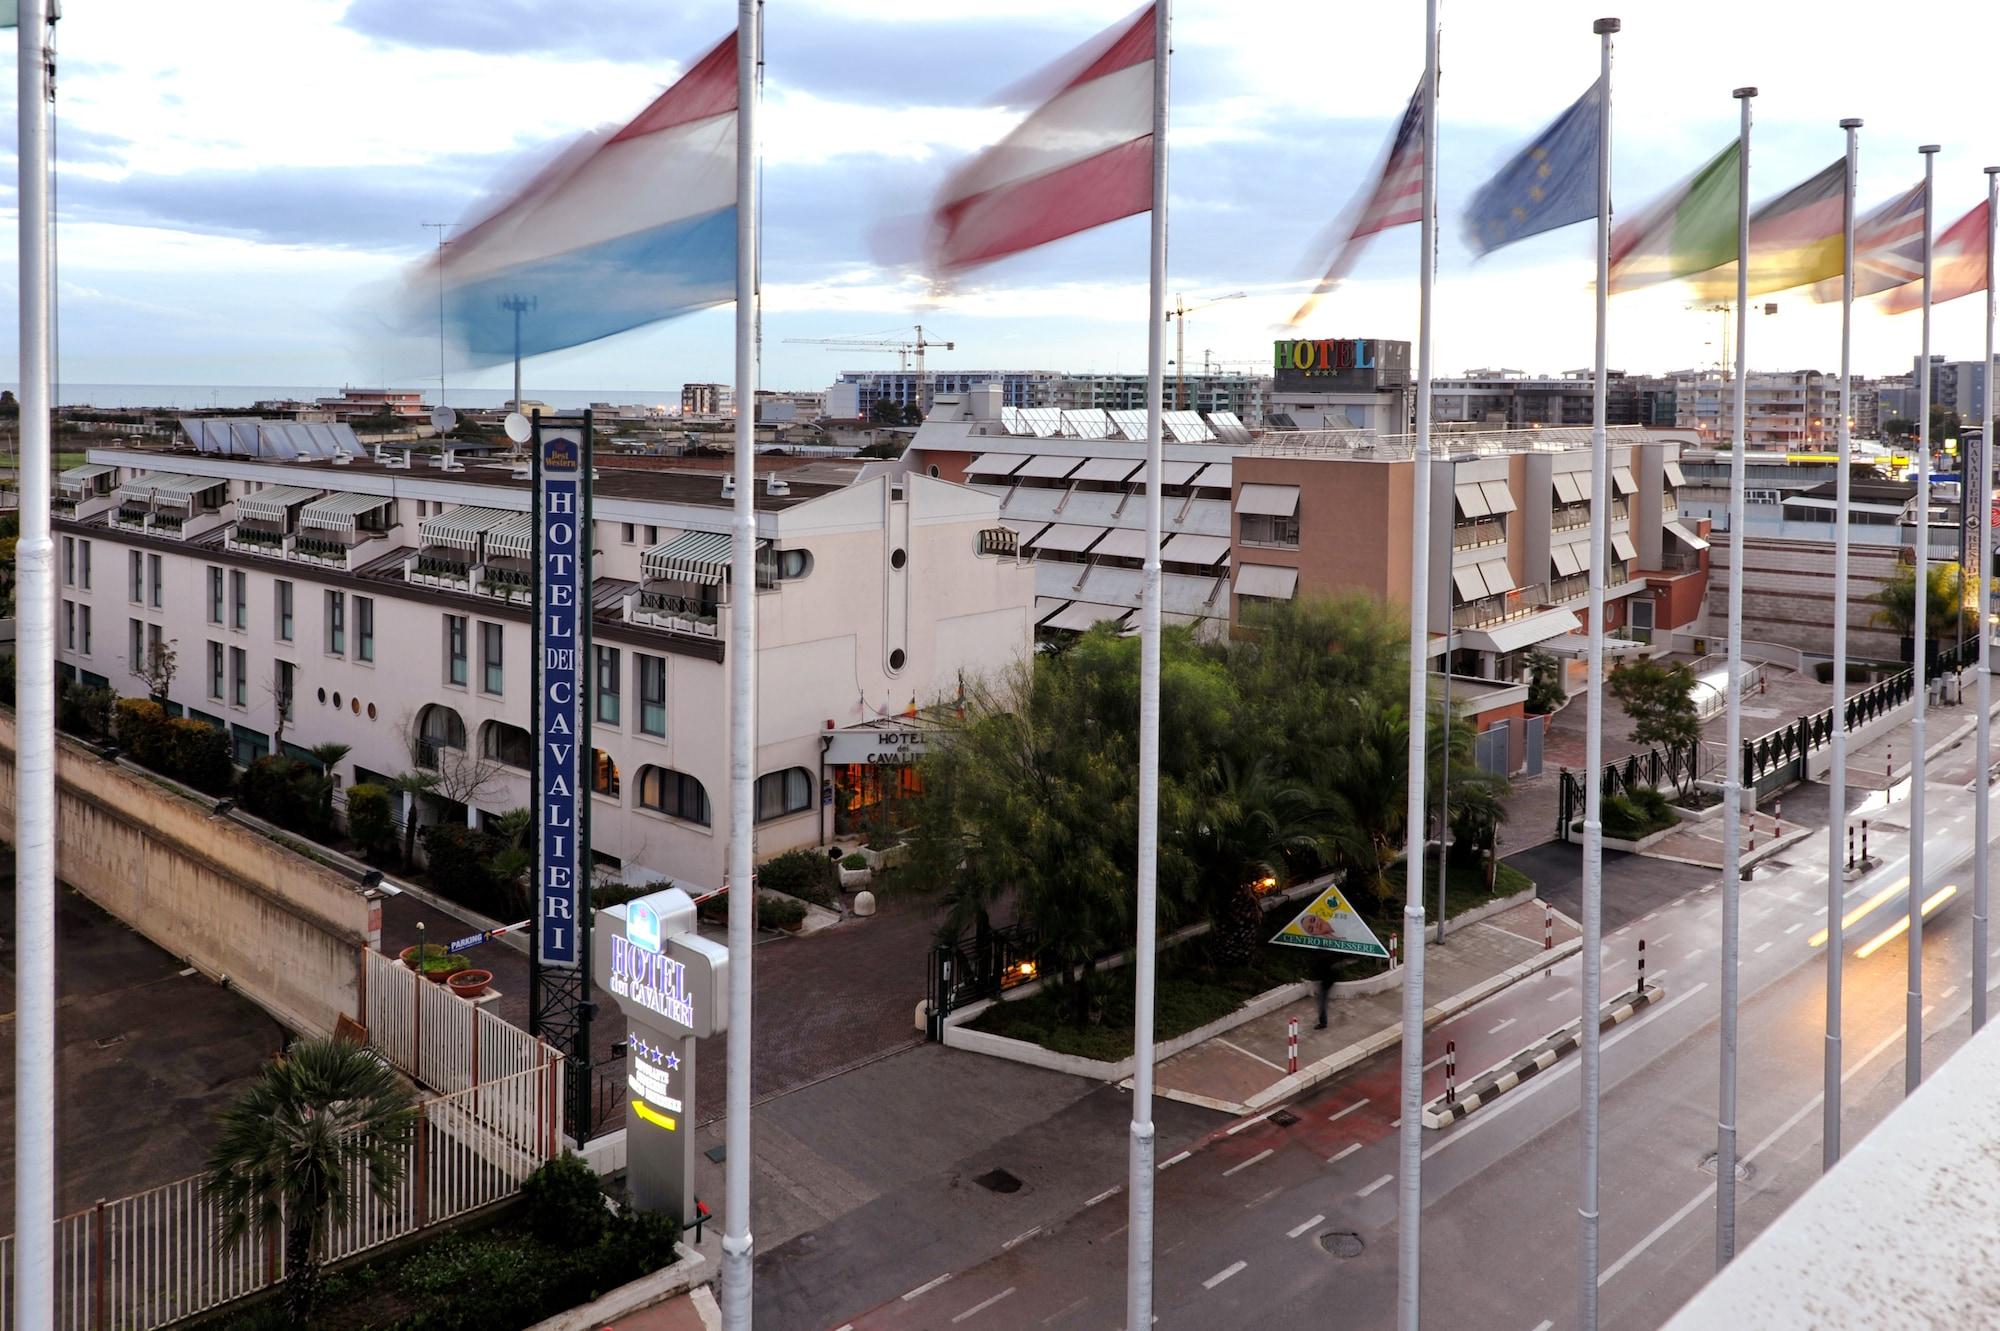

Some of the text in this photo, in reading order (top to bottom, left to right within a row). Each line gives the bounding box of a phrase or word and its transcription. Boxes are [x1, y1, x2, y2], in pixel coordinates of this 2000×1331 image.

[1274, 338, 1375, 369] HOTEL
[545, 457, 576, 467] Western
[551, 450, 569, 460] Best
[1969, 441, 1980, 513] CAVALIERI
[1967, 535, 1977, 606] RESIDECE
[546, 491, 574, 950] HOTEL DEI CAVALIERI
[879, 733, 928, 744] HOTEL
[897, 744, 909, 752] dei
[867, 753, 923, 763] CAVALIE
[451, 933, 483, 950] PARKING
[1282, 934, 1376, 953] CENTRO BENESSERE
[611, 934, 692, 1008] HOTEL
[611, 971, 694, 1029] dei CAVALIERI
